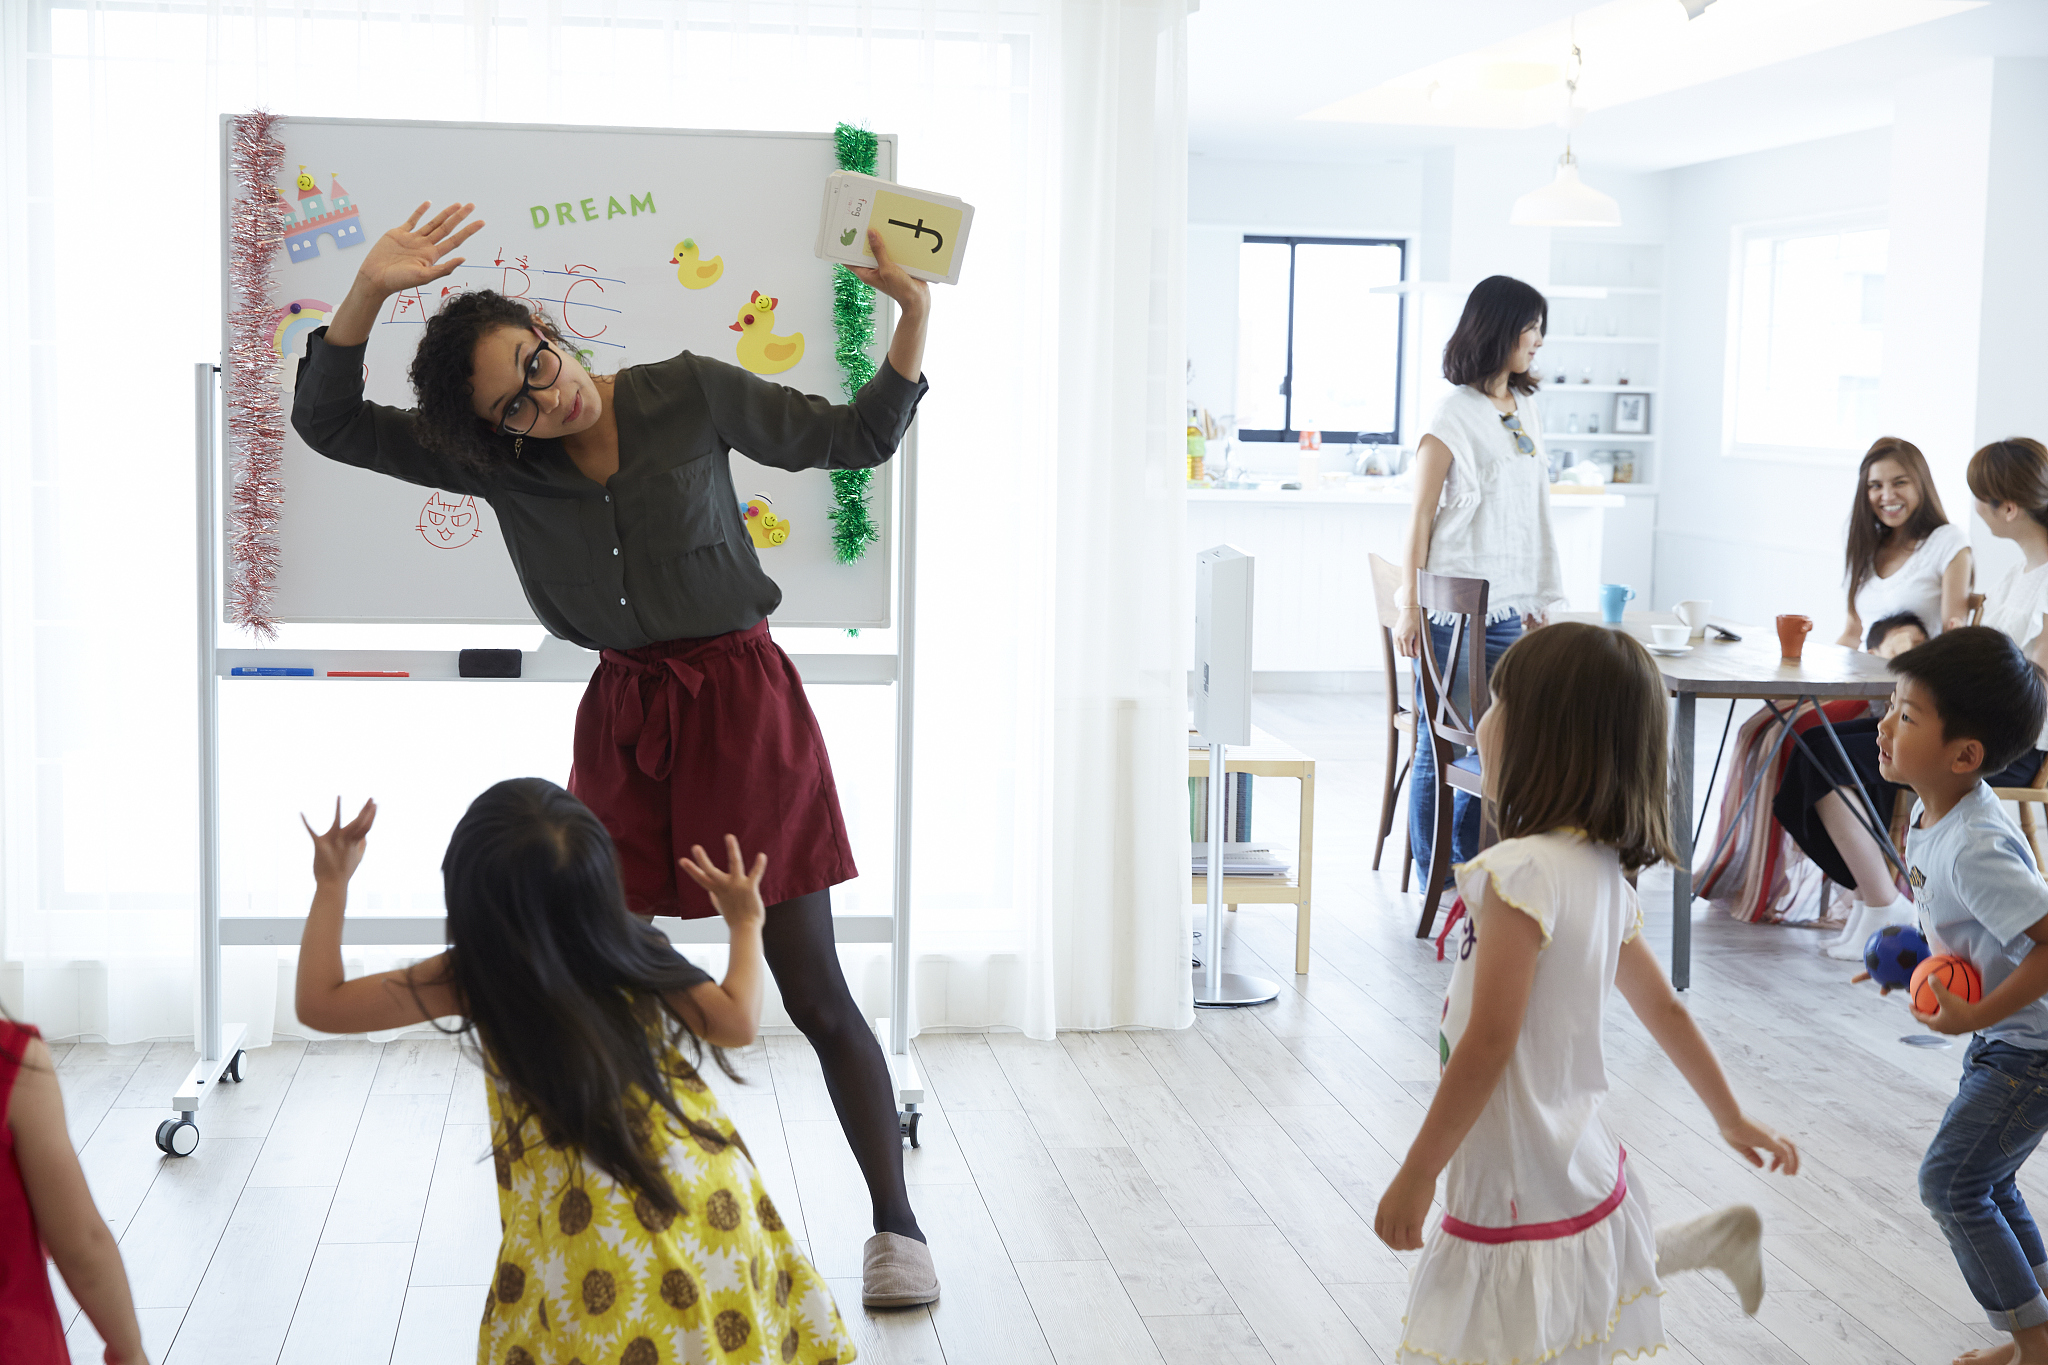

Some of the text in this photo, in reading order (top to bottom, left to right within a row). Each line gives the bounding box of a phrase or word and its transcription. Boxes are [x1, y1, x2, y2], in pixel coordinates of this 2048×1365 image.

[529, 191, 656, 229] DREAM
[851, 198, 868, 217] frog
[888, 218, 943, 254] f
[564, 278, 607, 338] C
